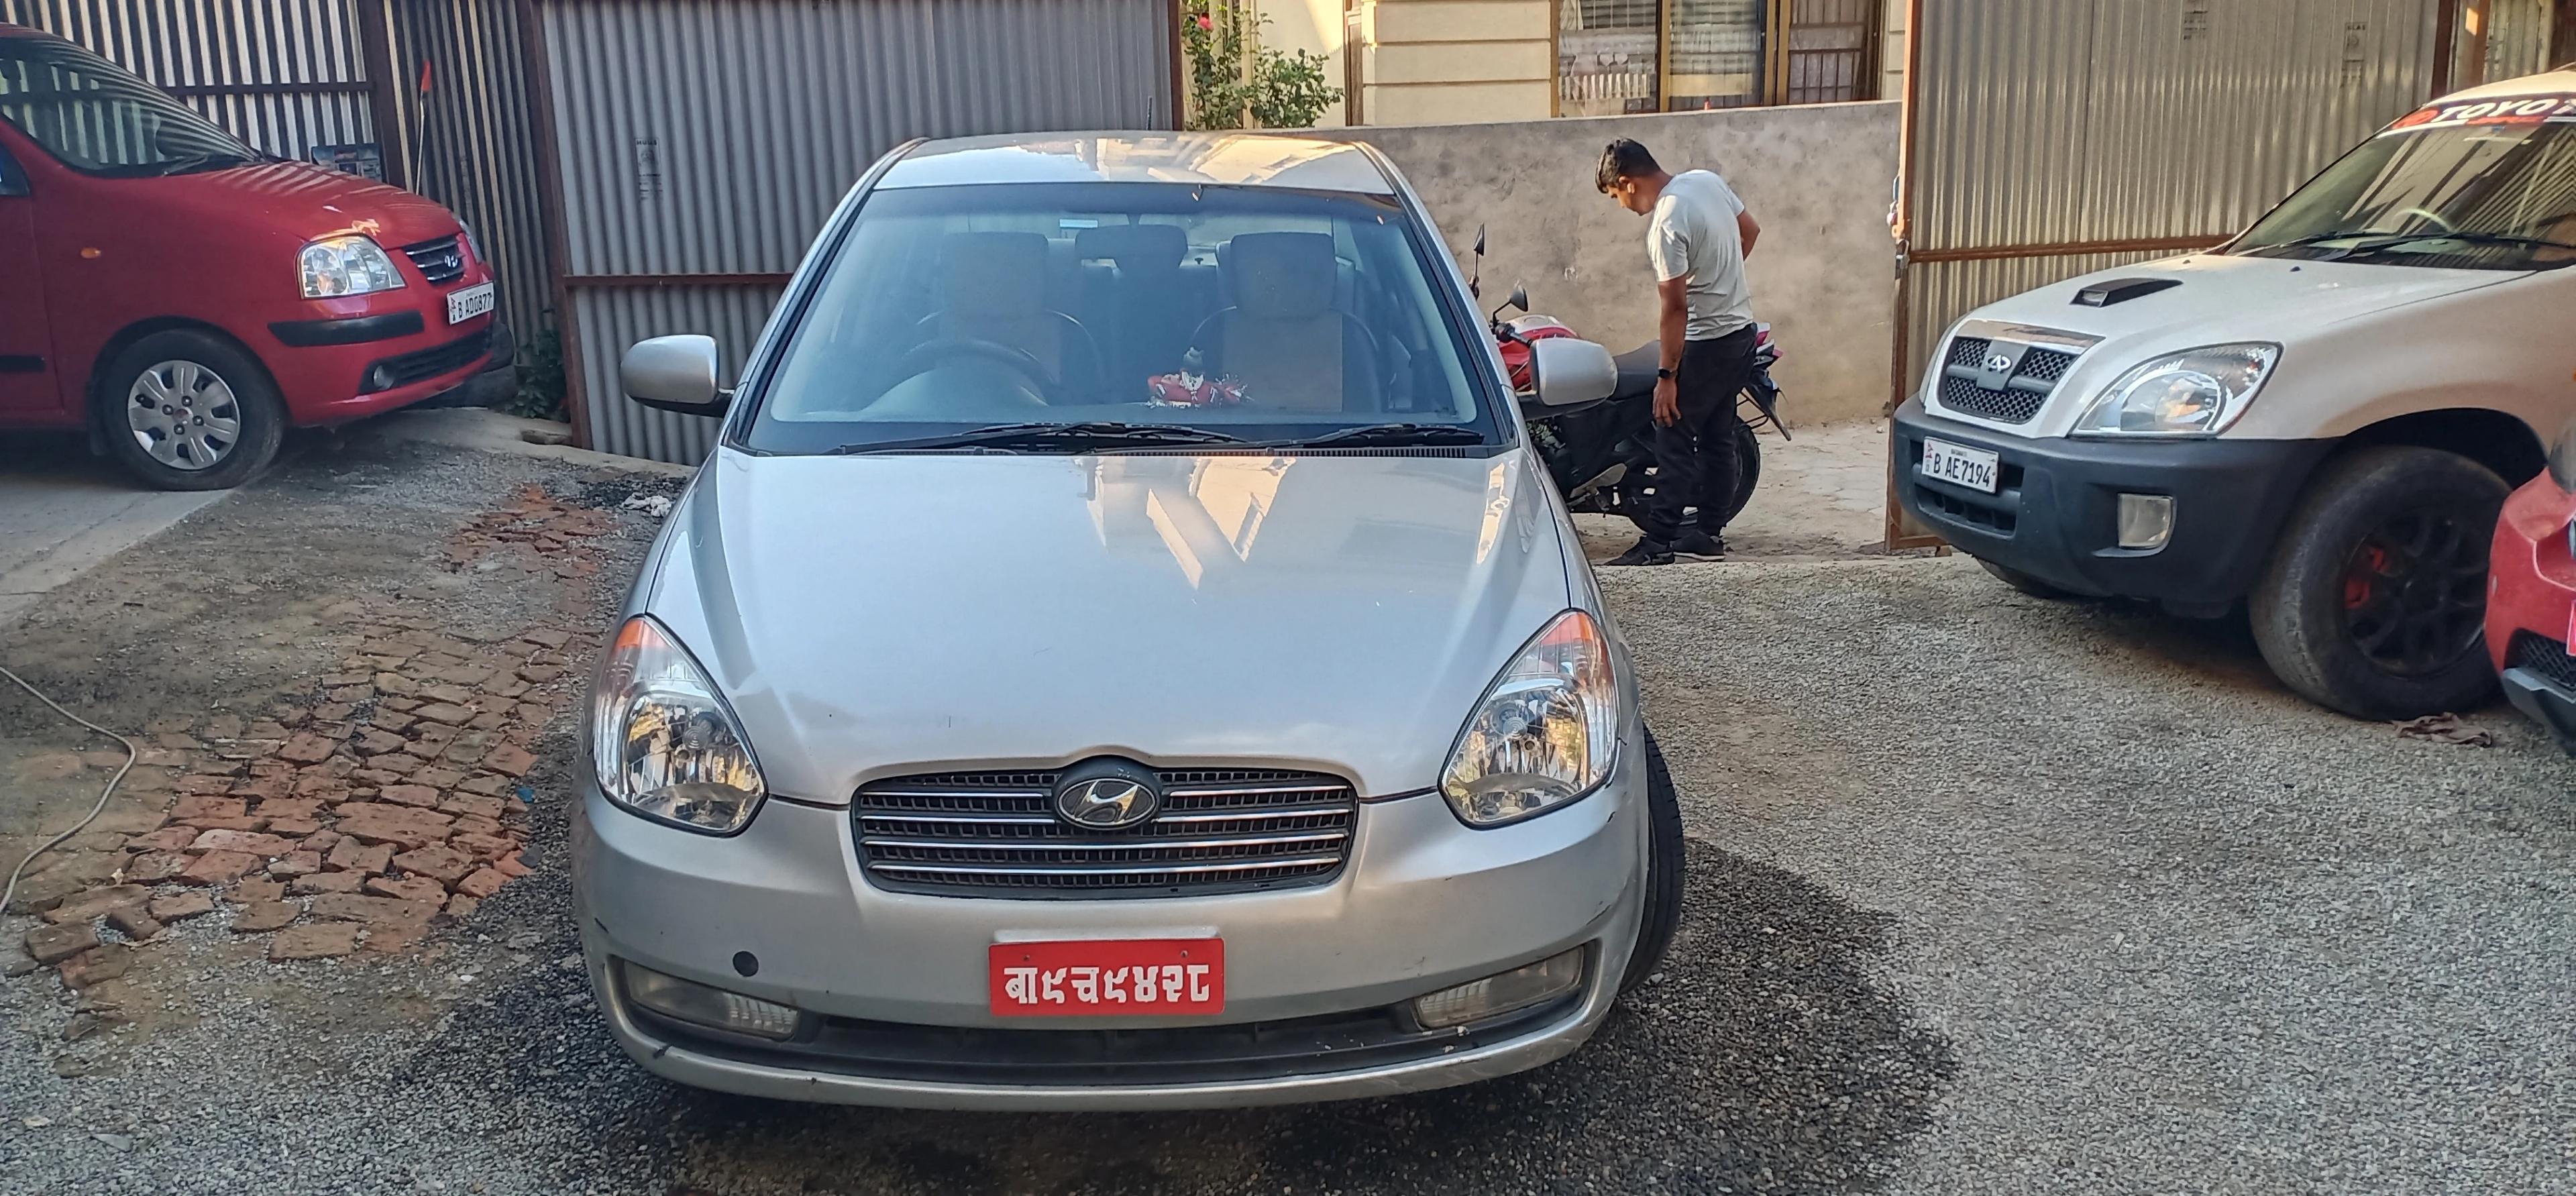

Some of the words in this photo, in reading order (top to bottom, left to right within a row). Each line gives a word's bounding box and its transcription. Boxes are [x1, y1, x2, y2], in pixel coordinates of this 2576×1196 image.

[458, 302, 463, 319] B
[1933, 453, 1941, 474] B
[1945, 456, 1991, 488] AE7194
